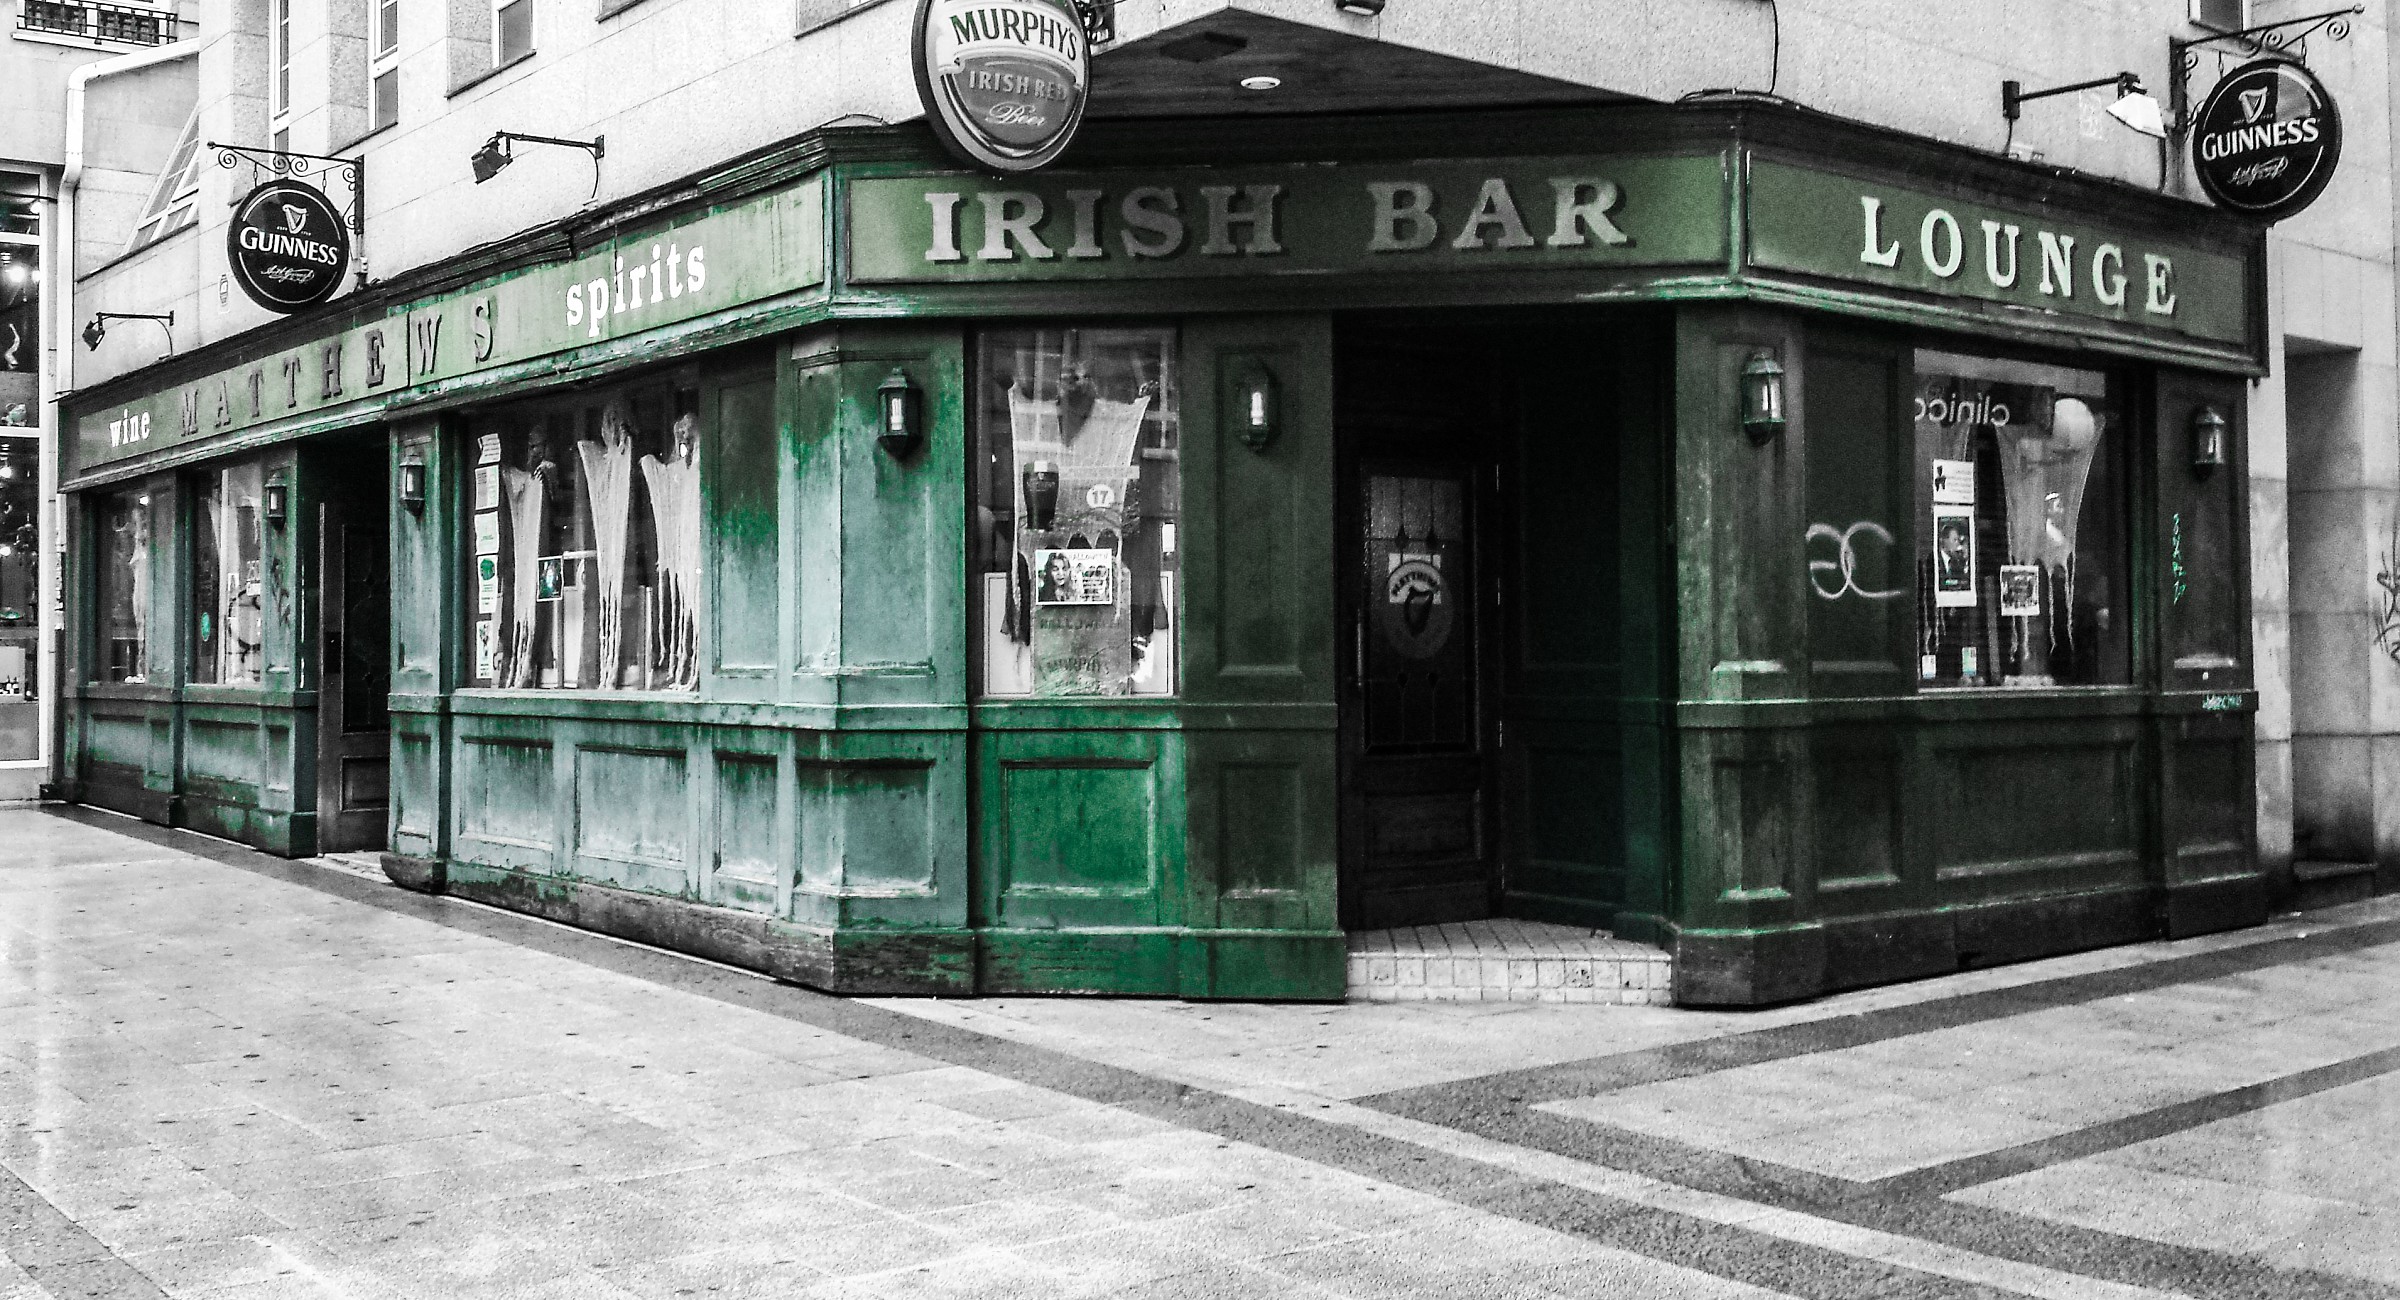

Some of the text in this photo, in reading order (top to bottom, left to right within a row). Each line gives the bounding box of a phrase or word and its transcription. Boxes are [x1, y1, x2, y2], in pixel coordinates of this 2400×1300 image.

[950, 8, 1077, 61] MURPHY'S
[969, 70, 1068, 101] IRISH RED
[985, 101, 1046, 126] Beer
[2202, 117, 2319, 161] GUINNESS
[925, 176, 1631, 262] IRISH BAR
[240, 226, 338, 265] GUINNESS
[1861, 196, 2176, 315] LOUNGE
[109, 243, 706, 447] wine MATTHEWS spirits
[1092, 490, 1109, 505] 17
